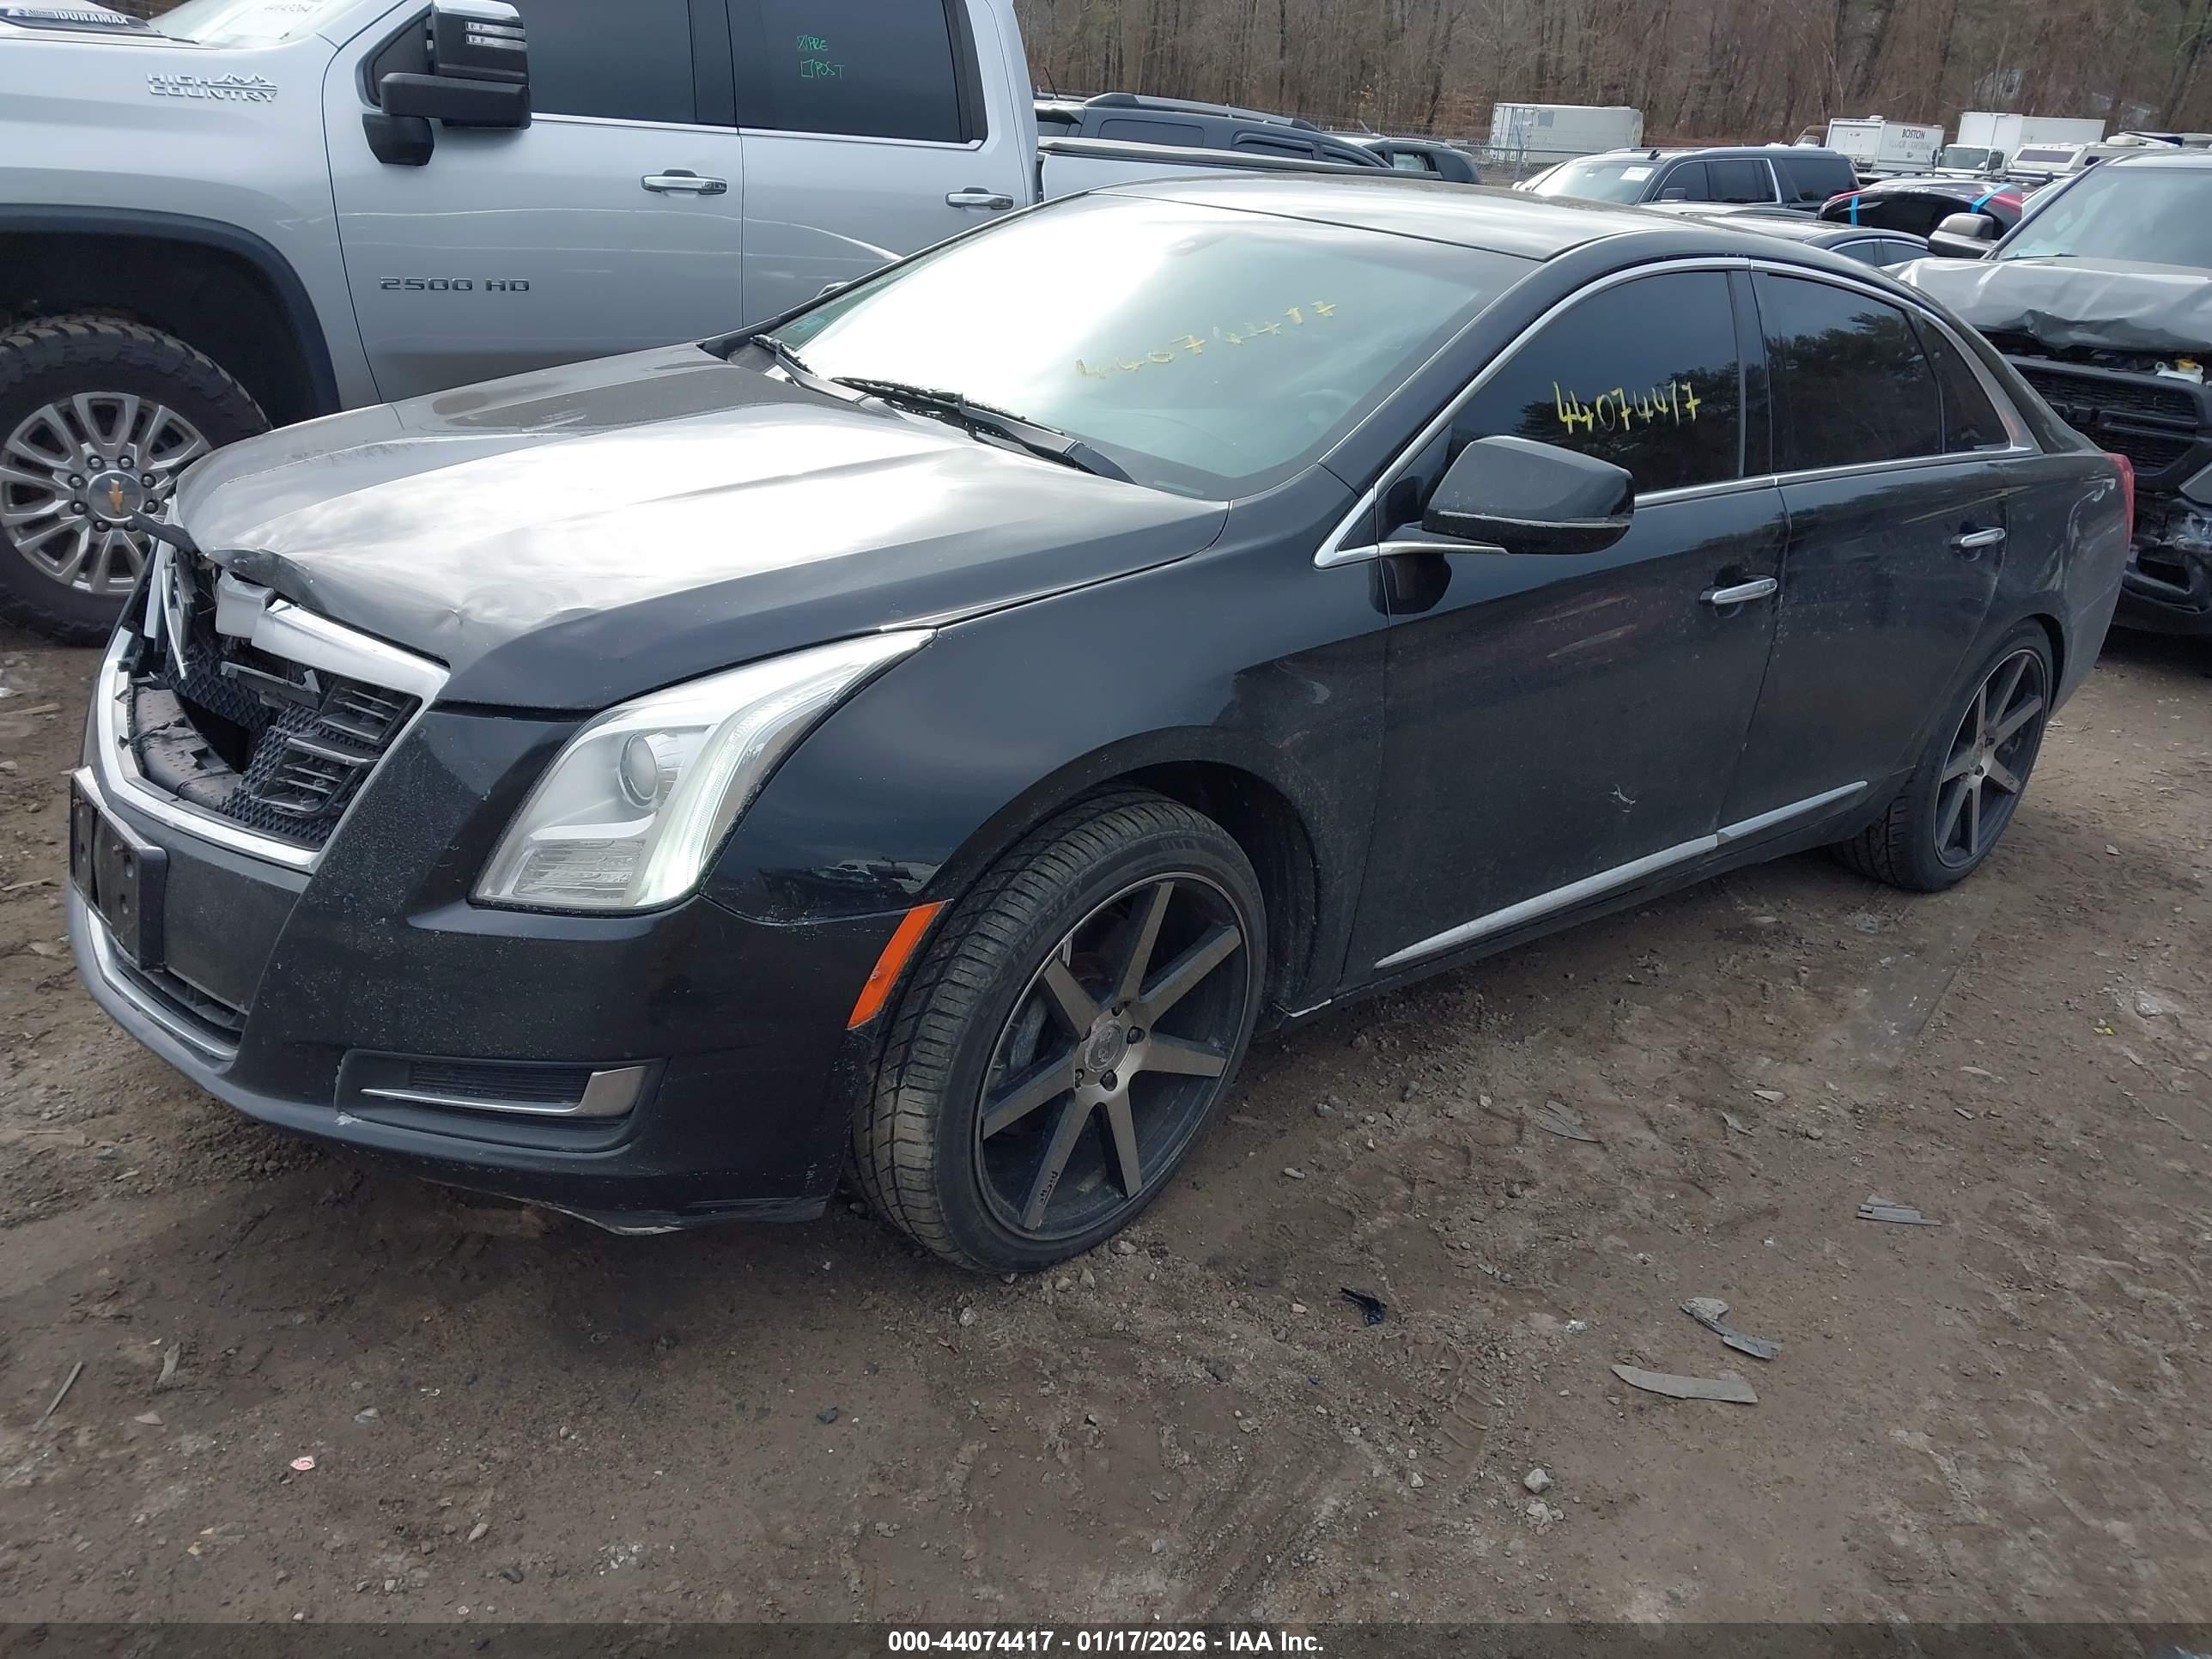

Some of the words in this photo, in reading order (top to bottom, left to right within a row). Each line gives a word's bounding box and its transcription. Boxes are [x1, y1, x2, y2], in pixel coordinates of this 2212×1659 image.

[59, 10, 129, 25] DURAMAX
[808, 36, 829, 52] PRE
[815, 60, 846, 80] POST
[146, 72, 213, 86] HIGH
[149, 84, 277, 103] COUNTRY
[1901, 128, 1926, 140] BOSTON
[380, 276, 473, 291] 2500
[485, 277, 530, 292] HD
[1553, 380, 1702, 435] 44074417
